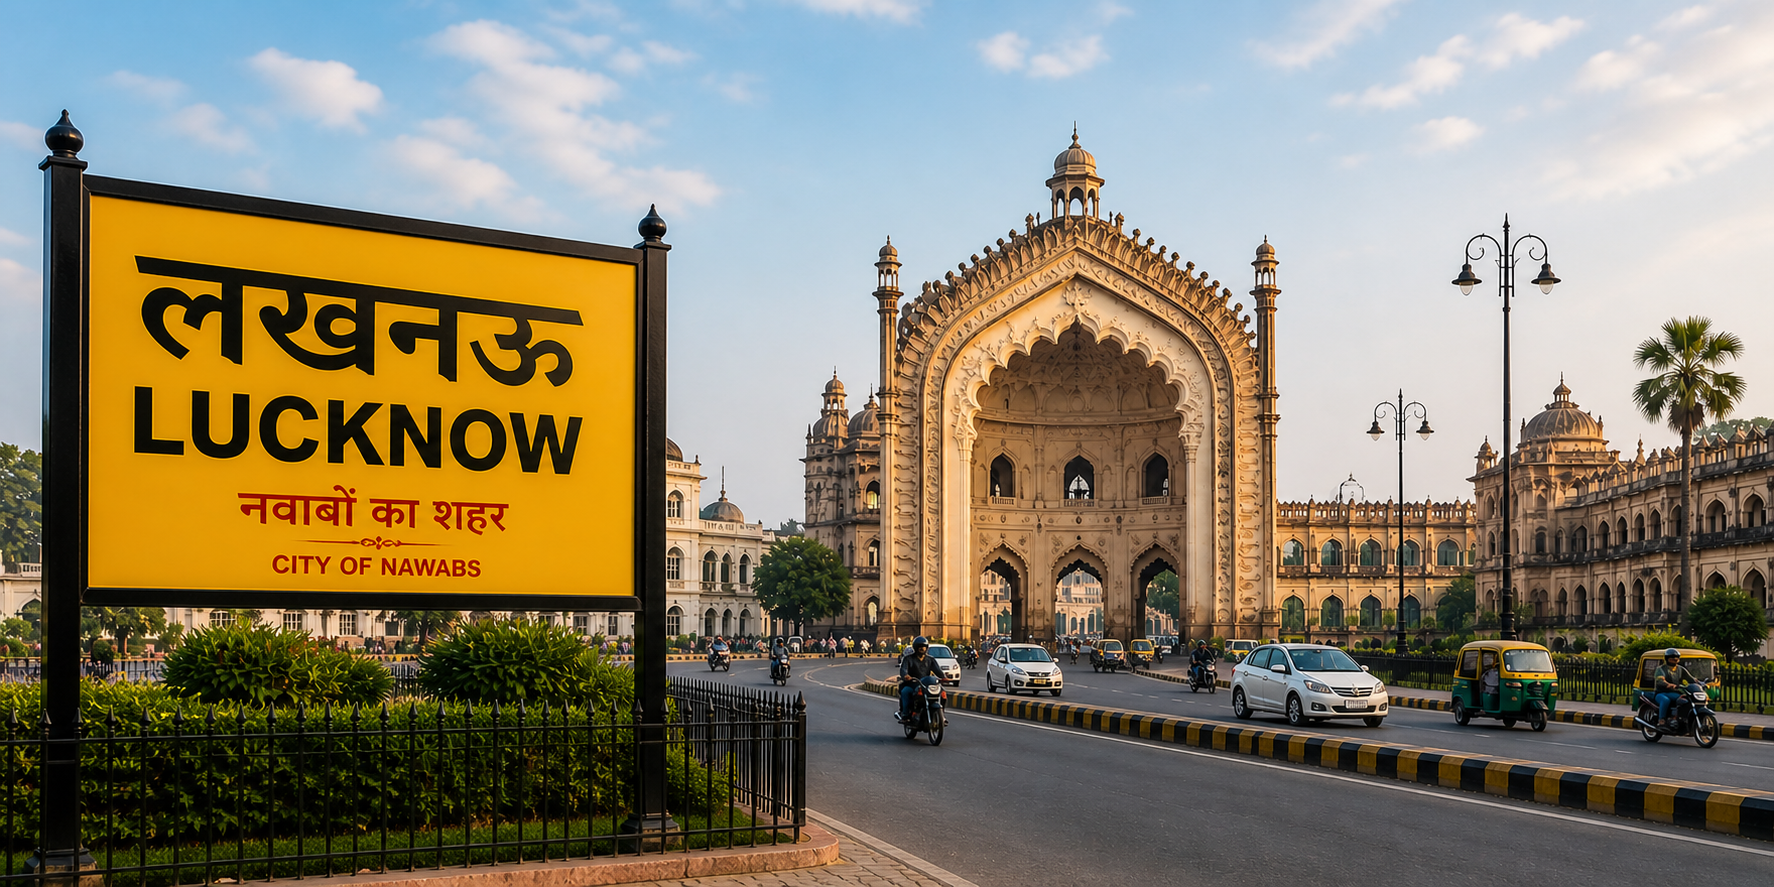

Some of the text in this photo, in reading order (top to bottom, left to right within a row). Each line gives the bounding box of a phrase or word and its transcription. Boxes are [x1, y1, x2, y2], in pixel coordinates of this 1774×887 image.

[134, 255, 584, 388] लखनऊ
[134, 386, 583, 475] LUCKNOW
[237, 485, 510, 535] नवाबों का शहर
[272, 555, 482, 577] CITY OF NAWABS
